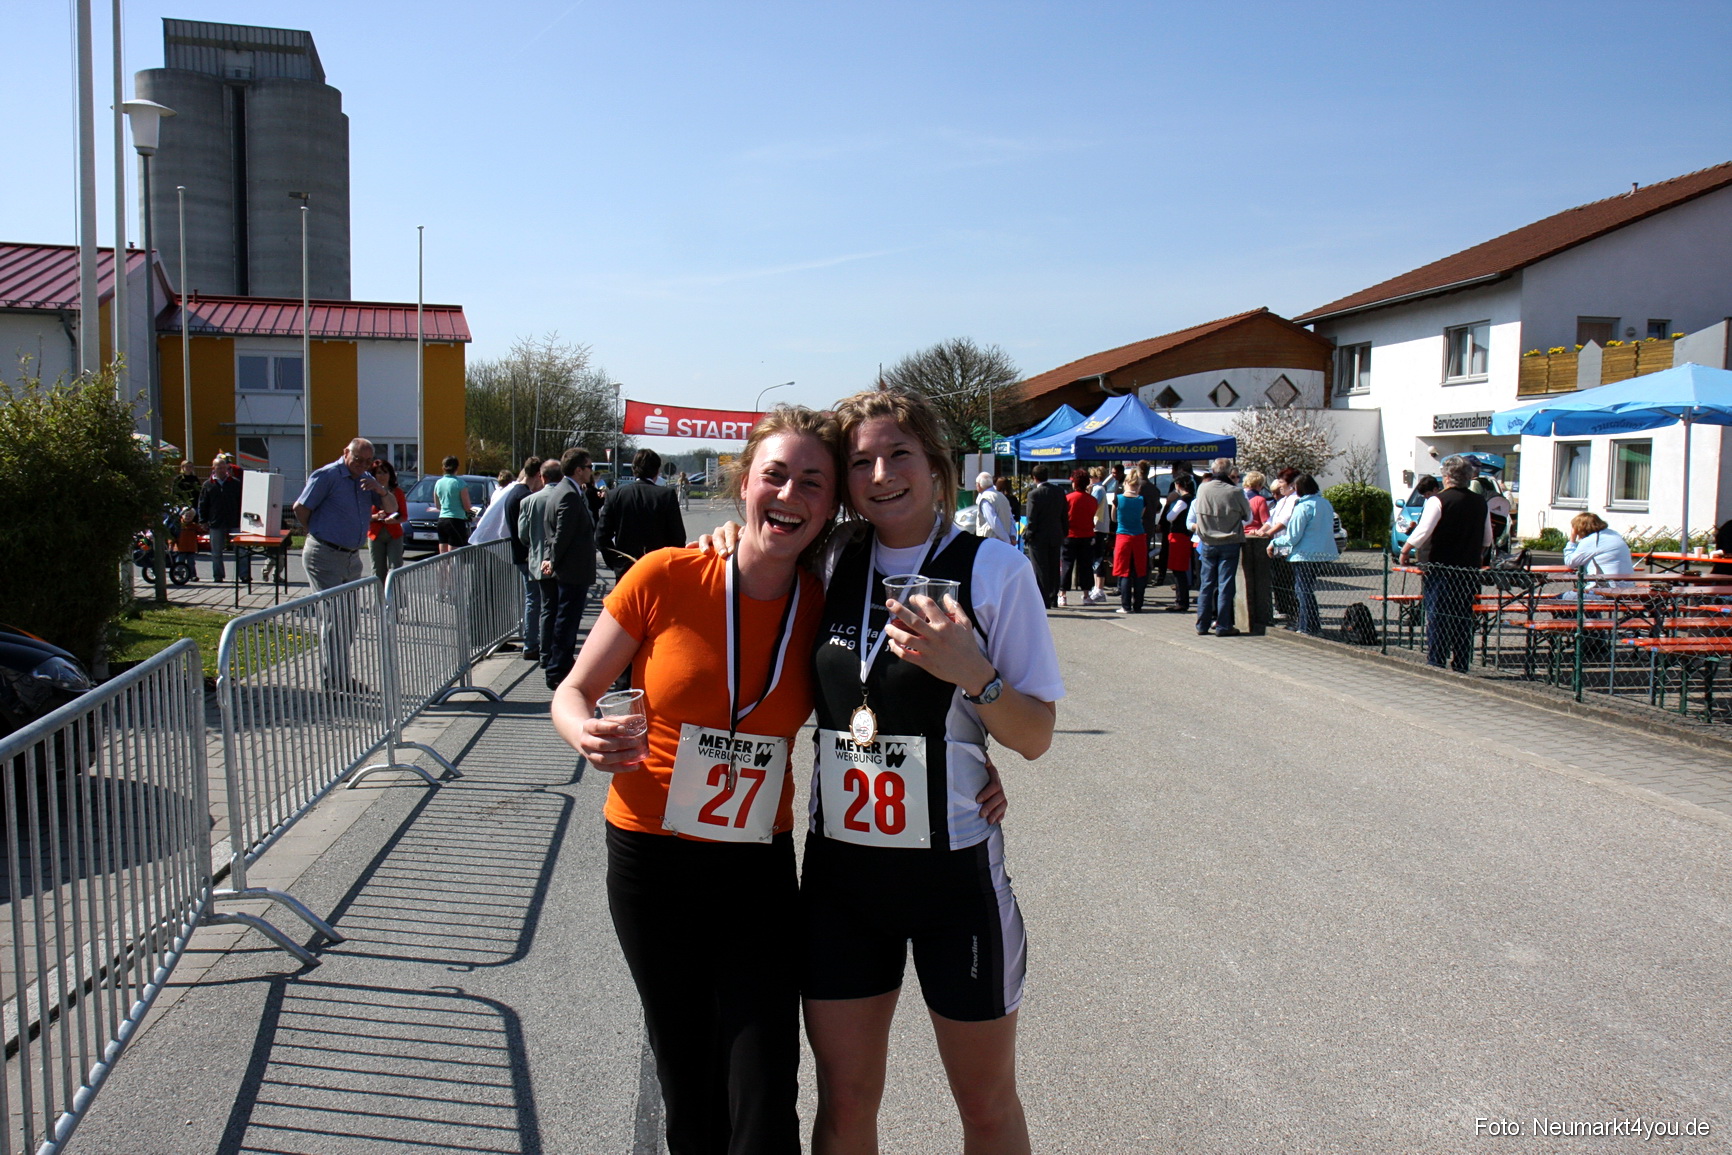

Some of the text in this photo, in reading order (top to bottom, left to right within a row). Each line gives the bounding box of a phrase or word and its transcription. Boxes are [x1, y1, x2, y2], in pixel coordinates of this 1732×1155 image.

[676, 418, 752, 440] START
[1433, 412, 1492, 430] Serviceannahme
[1095, 443, 1219, 454] www.emmanet.com
[829, 622, 857, 635] LLC
[698, 733, 754, 754] MEYER
[835, 737, 882, 755] MEYER
[697, 746, 752, 764] WERBUNG
[834, 750, 883, 765] WERBUNG
[698, 763, 767, 829] 27
[844, 768, 907, 836] 28
